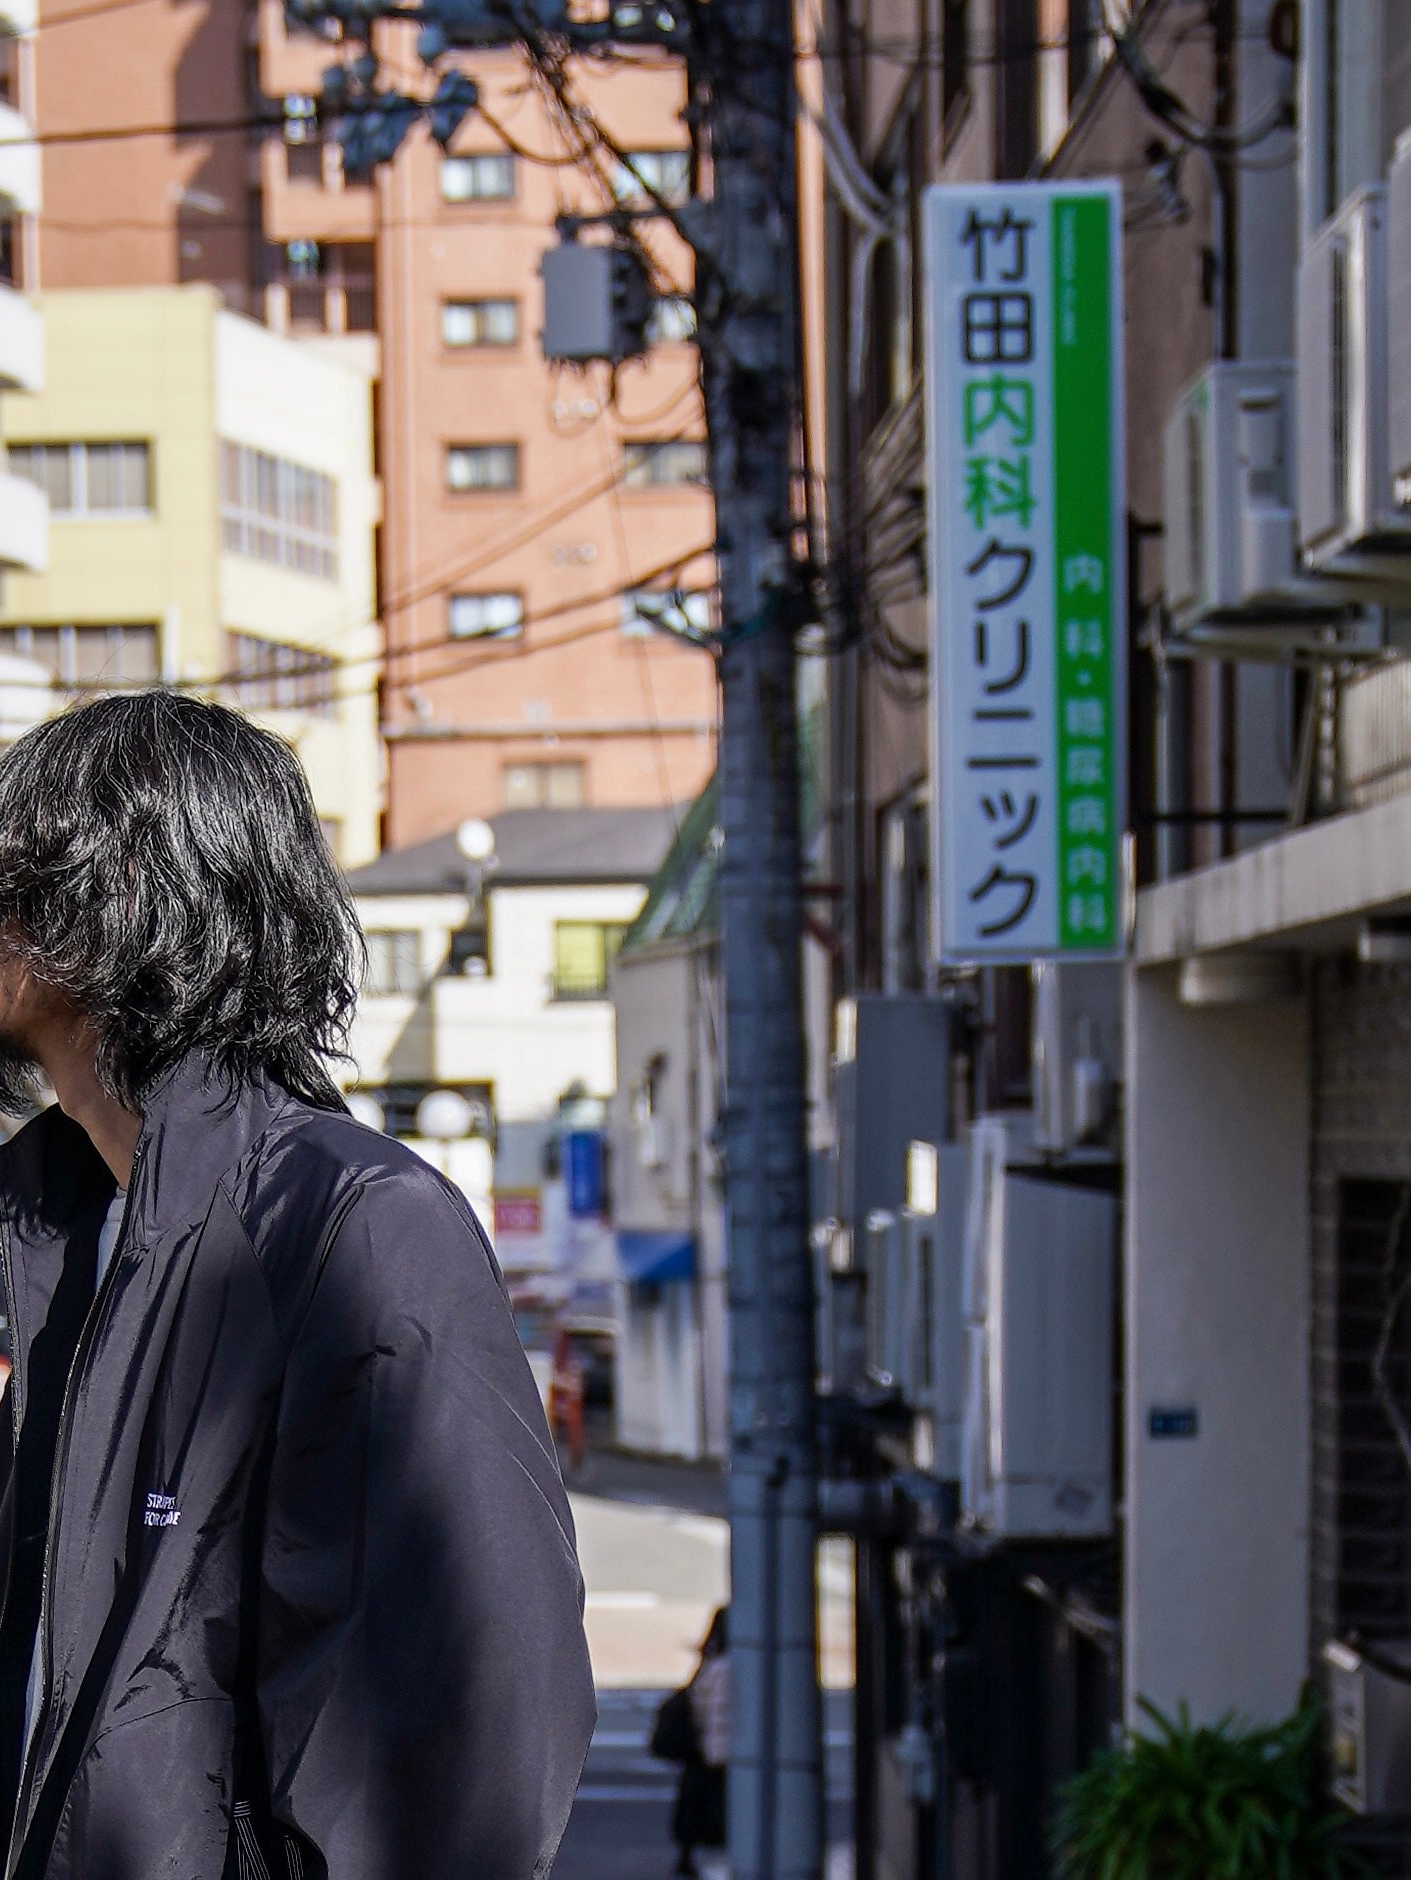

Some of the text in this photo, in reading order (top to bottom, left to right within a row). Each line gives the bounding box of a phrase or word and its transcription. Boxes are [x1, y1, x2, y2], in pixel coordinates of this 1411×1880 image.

[959, 206, 1040, 938] 竹田内科クリニック
[144, 1511, 160, 1526] FOR
